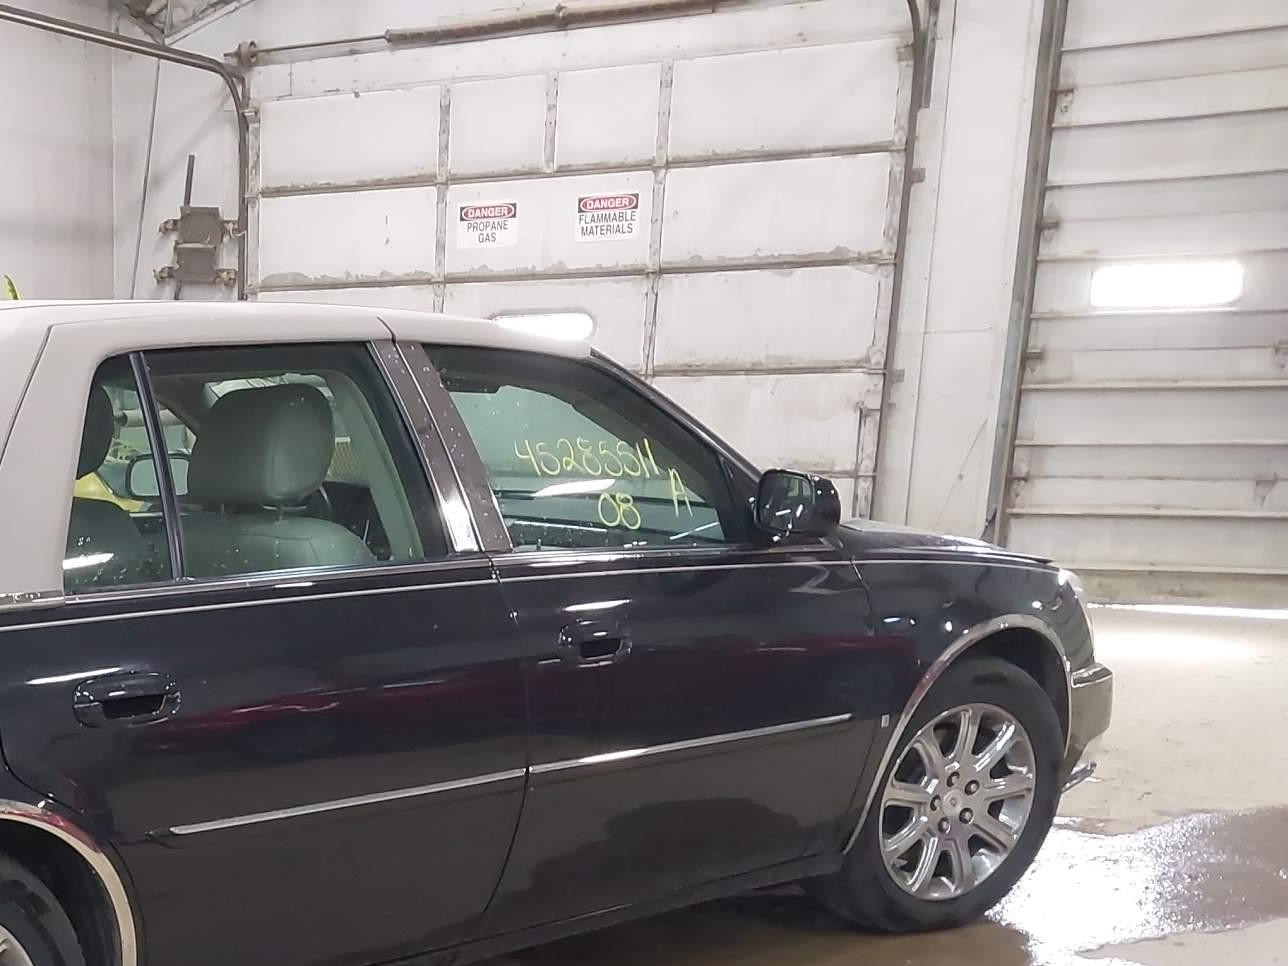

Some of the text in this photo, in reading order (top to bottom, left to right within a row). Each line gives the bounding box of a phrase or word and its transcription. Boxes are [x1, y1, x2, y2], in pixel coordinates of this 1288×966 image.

[586, 197, 630, 209] DANGER
[468, 206, 508, 218] DANGER
[579, 210, 637, 225] FLAMMABLE
[467, 219, 509, 232] PROPANE
[581, 222, 633, 237] MATERIALS
[478, 232, 497, 243] GAS
[668, 467, 693, 518] A
[598, 492, 641, 530] 08
